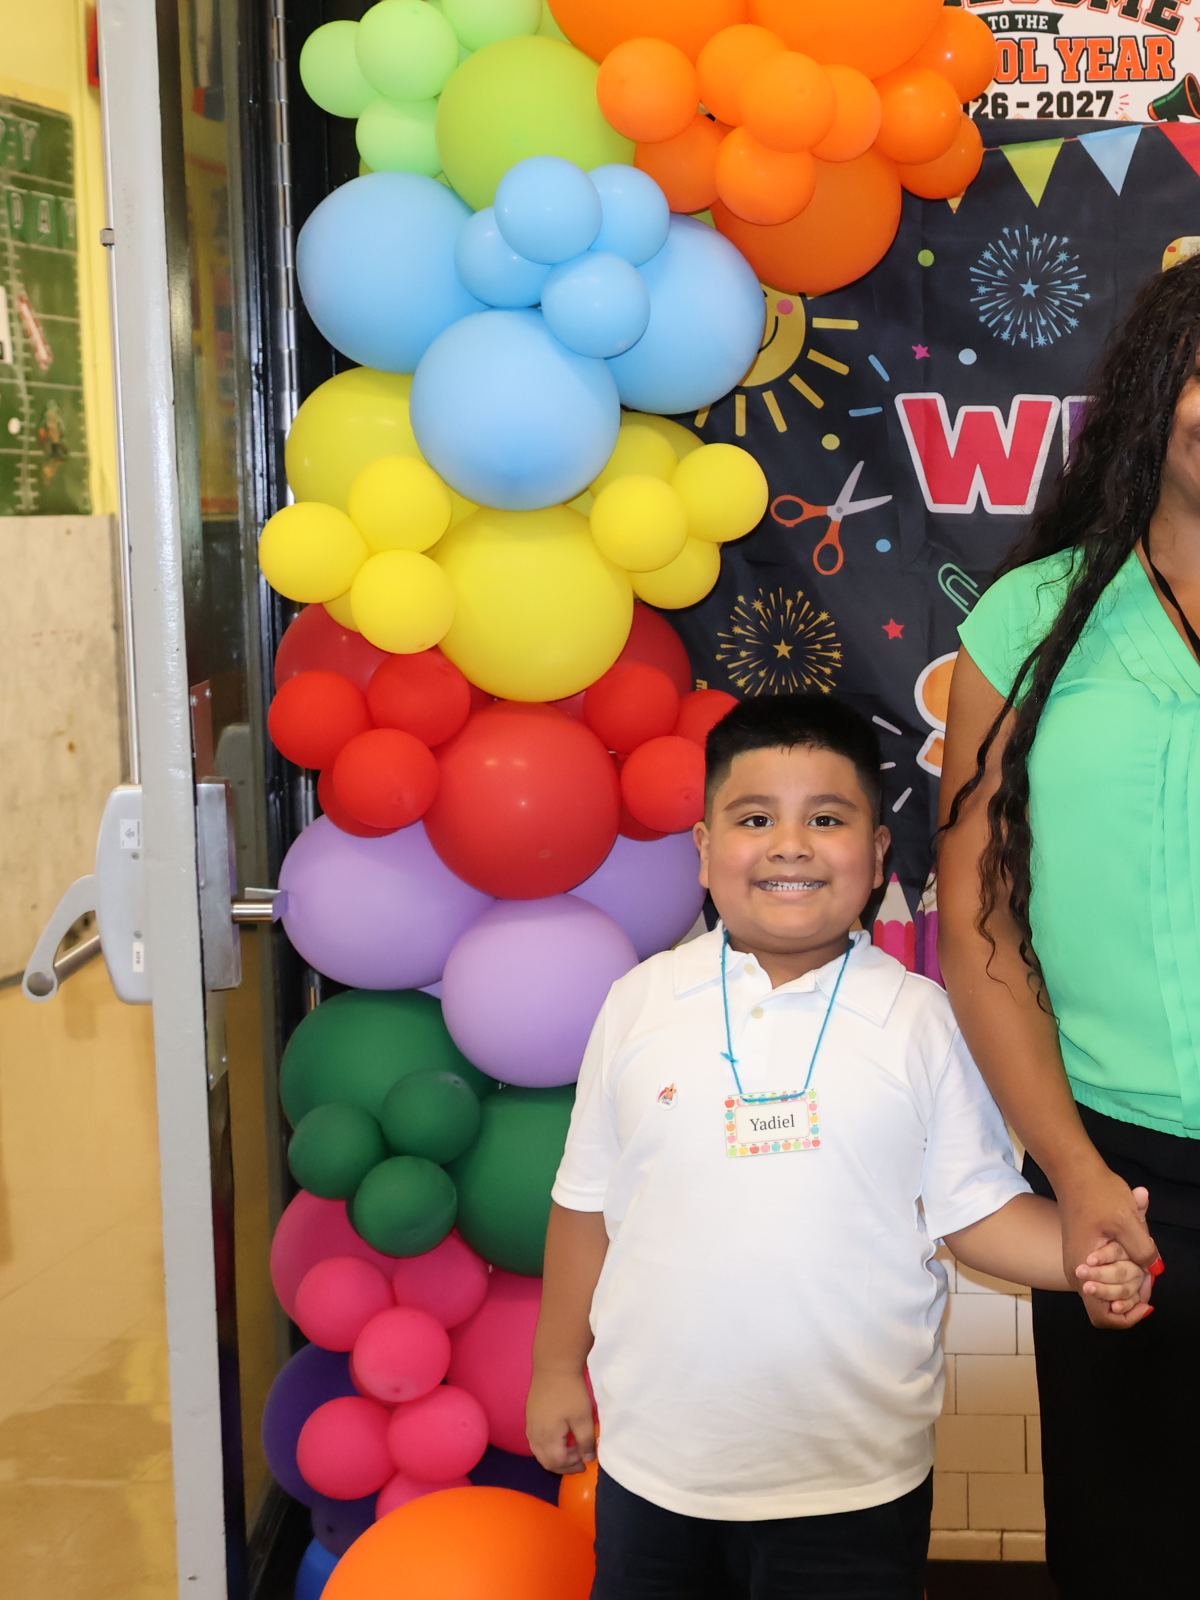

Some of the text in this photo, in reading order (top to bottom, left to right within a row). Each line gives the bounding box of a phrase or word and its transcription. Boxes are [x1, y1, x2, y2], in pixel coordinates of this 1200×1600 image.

[988, 14, 1010, 31] TO
[1015, 13, 1050, 30] THE
[1054, 35, 1175, 84] YEAR
[1036, 90, 1114, 119] 2027
[749, 1114, 796, 1132] Yadiel
